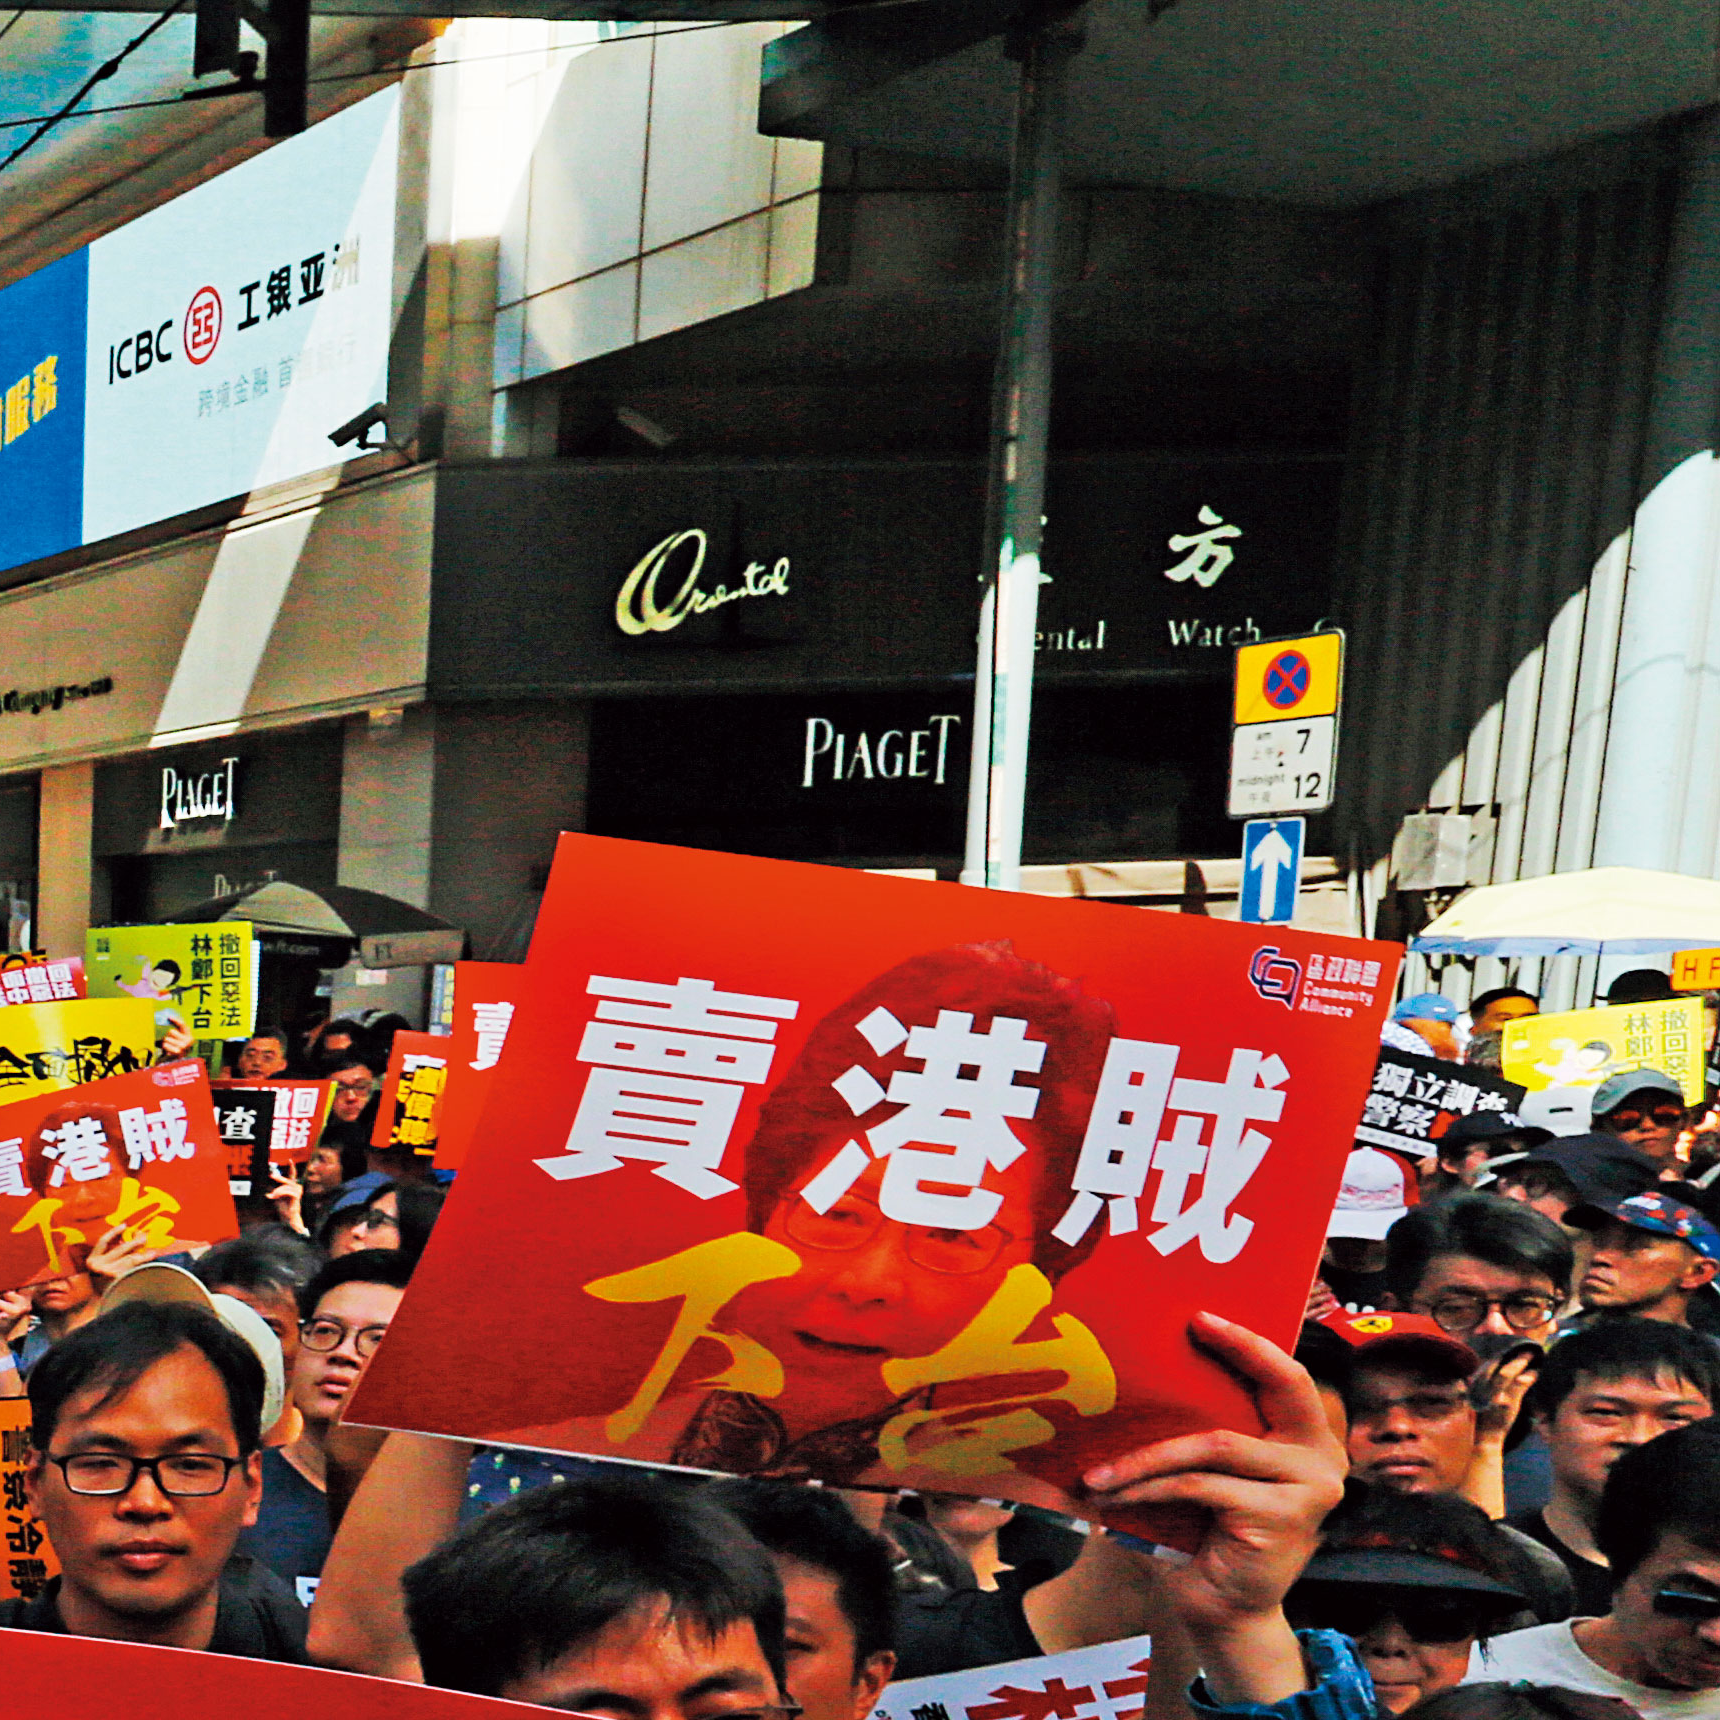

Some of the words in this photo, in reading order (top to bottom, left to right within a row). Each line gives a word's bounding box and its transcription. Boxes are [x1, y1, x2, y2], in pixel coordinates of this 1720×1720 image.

[108, 318, 174, 386] ICBC
[1163, 504, 1243, 588] 方
[1167, 617, 1263, 648] Watch
[801, 713, 961, 788] PIAGET
[1296, 728, 1312, 754] 7
[160, 756, 241, 830] PIAGET
[1294, 772, 1322, 799] 12
[190, 933, 215, 1031] 林鄭下台
[218, 931, 243, 1029] 撤回惡法
[1298, 996, 1355, 1018] Alliance
[1302, 981, 1375, 1009] Community
[1660, 1007, 1691, 1096] 撤回惡
[213, 1106, 257, 1141] 查
[532, 972, 1294, 1267] 賣港賊
[10, 1177, 182, 1275] 下台
[582, 1230, 1119, 1483] 下台
